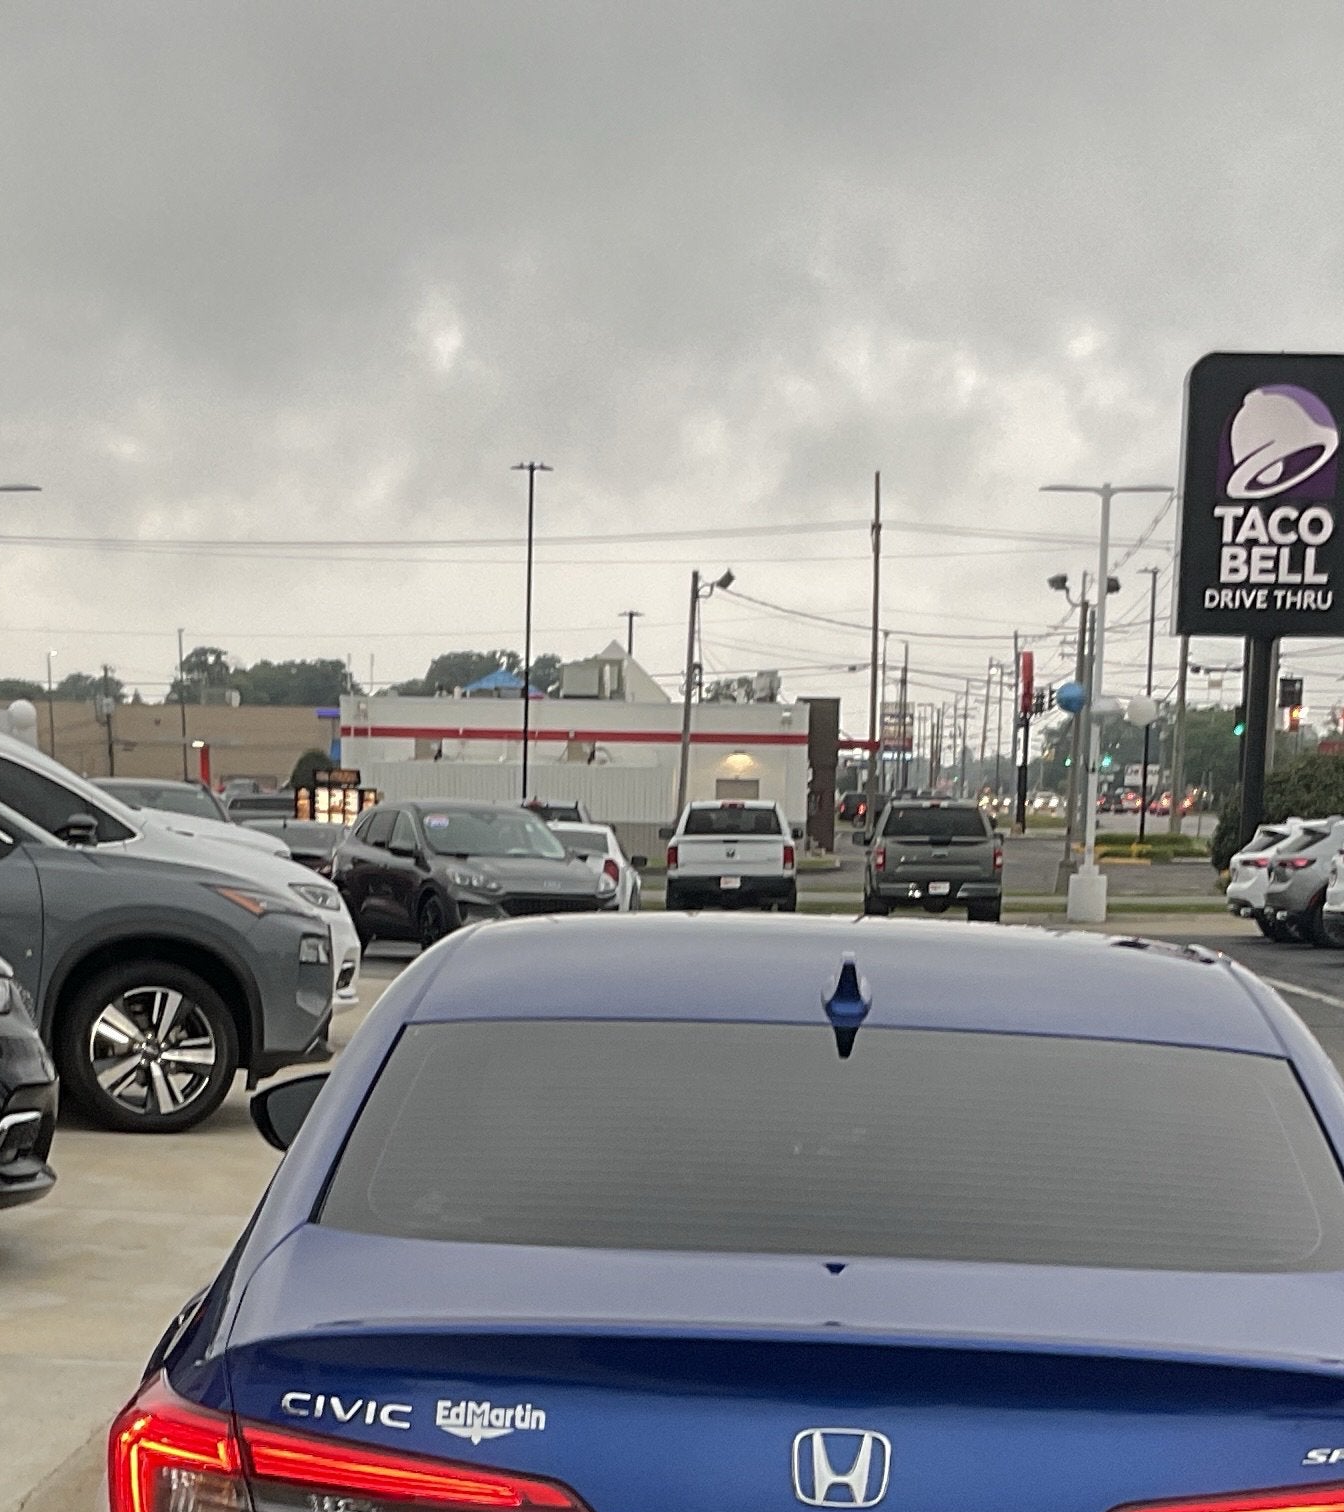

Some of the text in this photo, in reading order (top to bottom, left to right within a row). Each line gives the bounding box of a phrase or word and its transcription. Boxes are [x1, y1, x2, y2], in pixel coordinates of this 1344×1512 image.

[1213, 505, 1334, 545] TACO
[1219, 546, 1329, 585] BELL
[1204, 588, 1333, 610] DRIVE THRU
[281, 1391, 413, 1429] CIVIC
